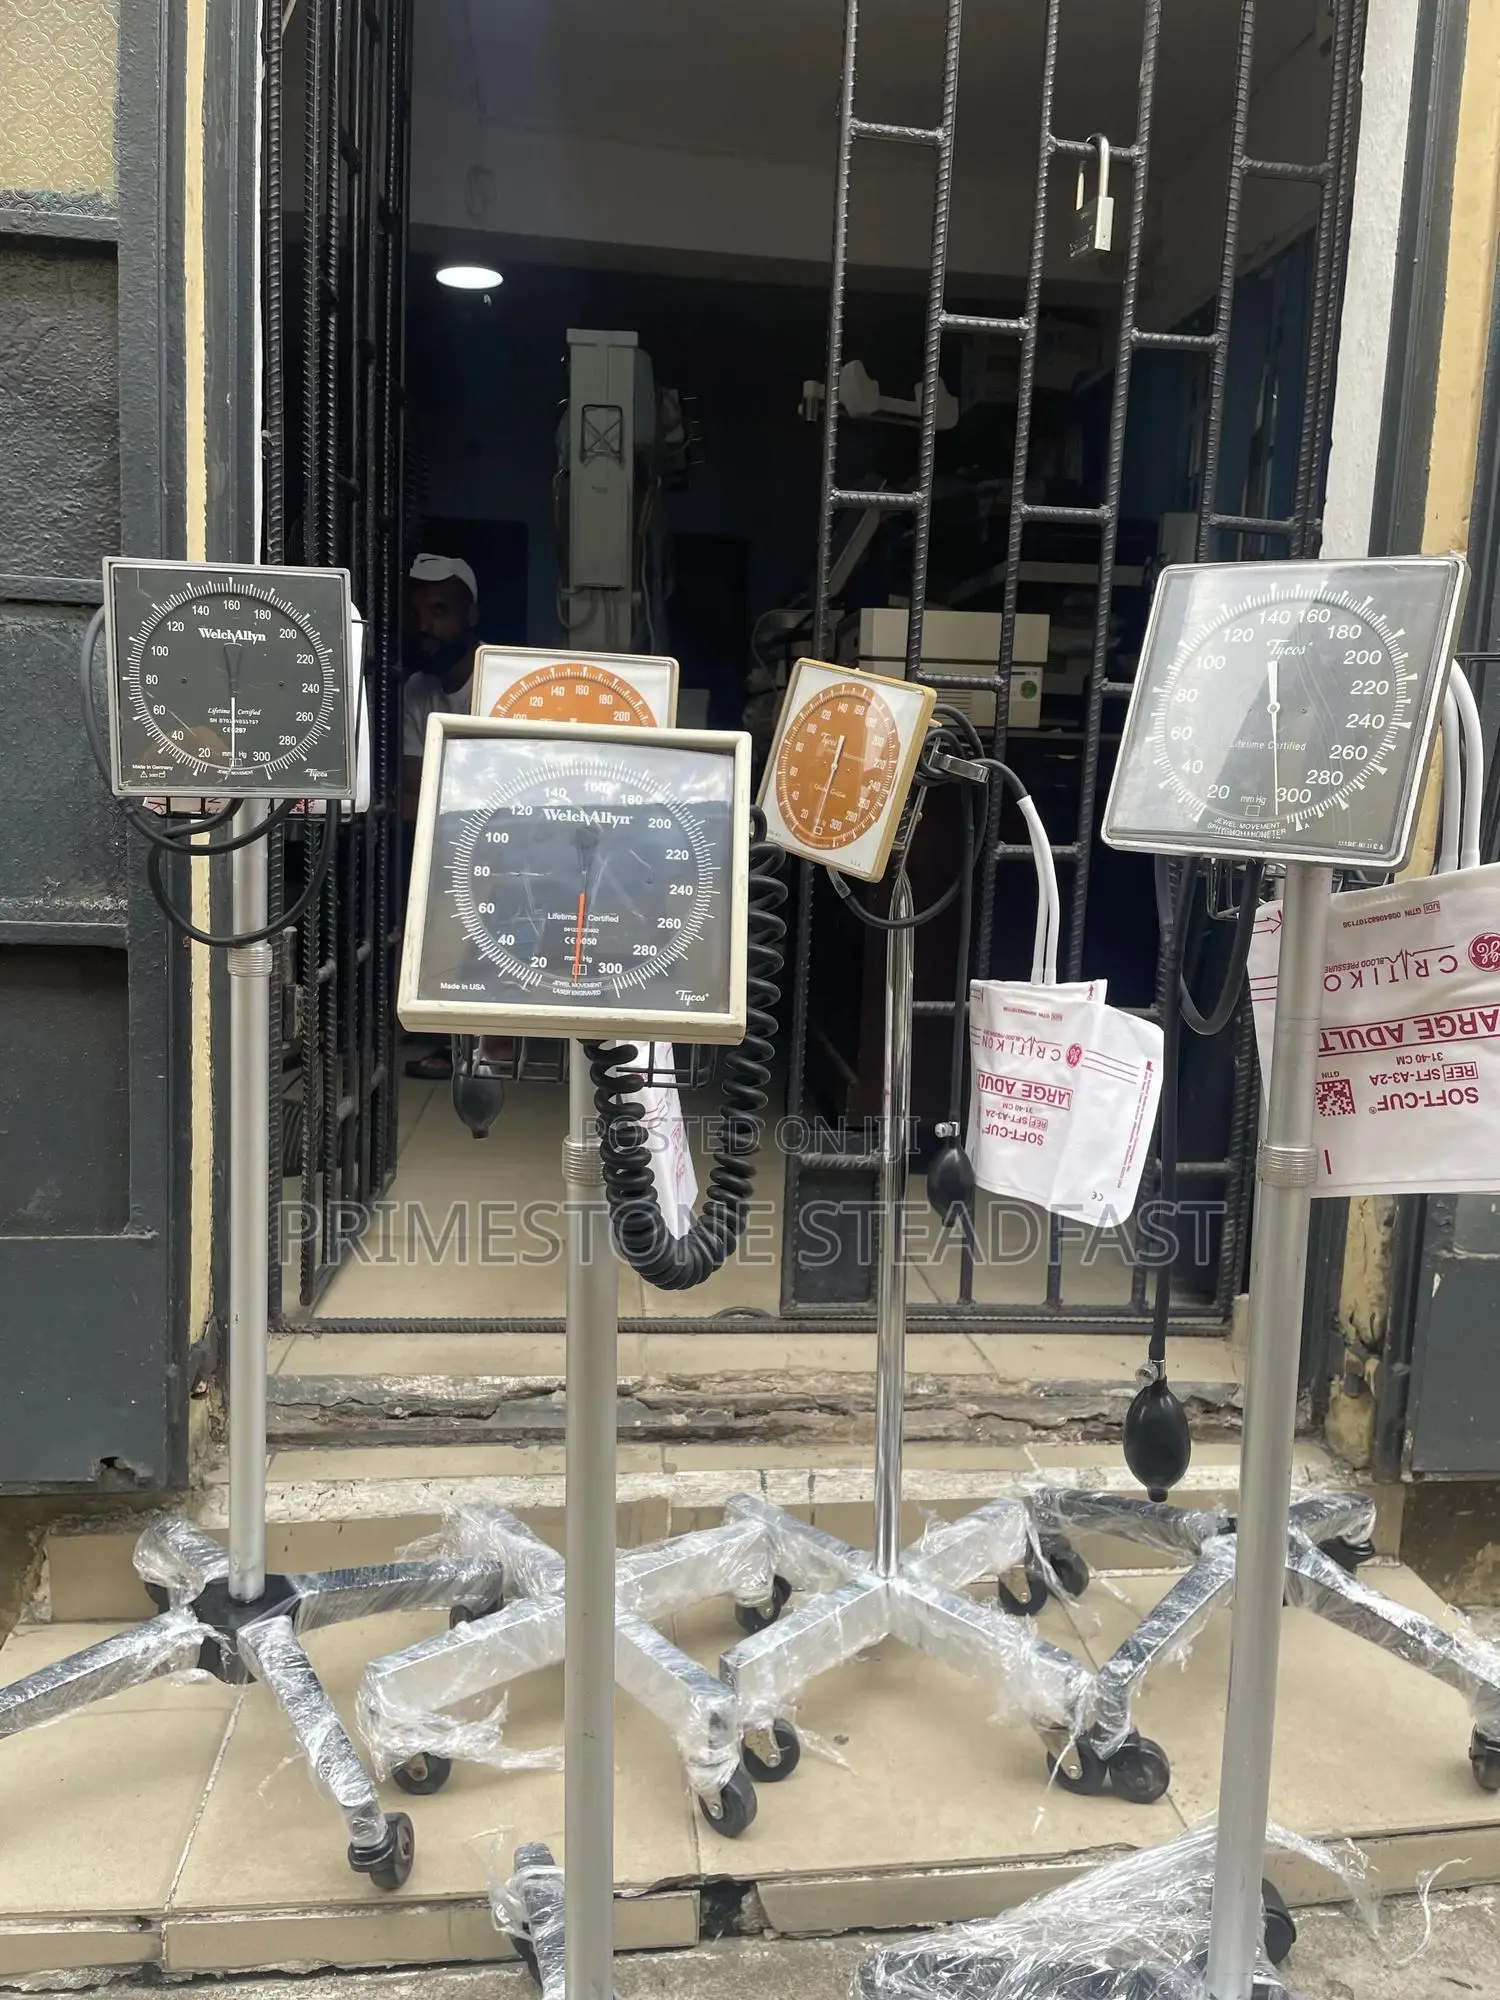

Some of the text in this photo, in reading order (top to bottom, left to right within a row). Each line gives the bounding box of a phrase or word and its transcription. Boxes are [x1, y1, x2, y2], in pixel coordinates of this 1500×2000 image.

[192, 606, 210, 615] 140
[223, 601, 241, 610] 160
[254, 610, 271, 620] 180
[1259, 610, 1291, 624] 140
[1298, 609, 1331, 623] 160
[167, 622, 184, 632] 120
[1327, 625, 1362, 639] 180
[198, 628, 266, 645] WelchAllyn
[279, 629, 297, 639] 200
[1223, 629, 1254, 642] 120
[152, 647, 169, 657] 100
[1266, 639, 1307, 659] Tycos
[297, 655, 314, 665] 220
[1196, 655, 1226, 669] 100
[1343, 650, 1382, 665] 200
[146, 675, 159, 685] 80
[302, 684, 320, 694] 240
[551, 686, 565, 697] 140
[575, 685, 590, 696] 160
[1350, 680, 1389, 695] 220
[599, 694, 613, 705] 180
[1176, 689, 1198, 702] 80
[529, 696, 544, 707] 120
[153, 705, 166, 715] 60
[296, 712, 314, 722] 260
[613, 711, 630, 722] 200
[1346, 714, 1385, 729] 240
[171, 731, 184, 741] 40
[1170, 726, 1193, 740] 60
[279, 736, 297, 746] 280
[1268, 740, 1307, 751] Certified
[198, 747, 211, 758] 20
[253, 751, 271, 761] 300
[1329, 744, 1368, 760] 260
[1181, 760, 1204, 774] 40
[1305, 769, 1344, 786] 280
[867, 779, 881, 792] 240
[543, 787, 567, 798] 140
[1206, 784, 1230, 799] 20
[1276, 787, 1312, 804] 300
[620, 794, 643, 805] 180
[1255, 794, 1267, 805] Hg
[510, 805, 533, 816] 120
[800, 808, 809, 819] 20
[543, 808, 630, 829] WelchAllyn
[648, 818, 672, 829] 200
[1214, 816, 1281, 830] JEWEL MOVEMENT
[485, 833, 509, 844] 100
[665, 850, 689, 861] 220
[474, 866, 491, 877] 80
[669, 885, 694, 896] 240
[478, 903, 495, 914] 60
[1404, 908, 1422, 917] GTIN
[547, 912, 619, 923] Lifetime Certified
[657, 918, 682, 929] 260
[498, 935, 515, 946] 40
[633, 945, 657, 956] 280
[530, 957, 548, 968] 20
[582, 955, 593, 964] Hg
[598, 962, 623, 974] 300
[1324, 957, 1385, 974] BLOOD PRESSURE
[1324, 953, 1458, 992] CRITIKO
[440, 982, 461, 990] Made
[469, 983, 486, 991] USA
[675, 989, 706, 1006] Tycos
[1318, 1009, 1500, 1052] ARGE ADULT
[981, 1036, 1061, 1062] CRITIKON
[1396, 1052, 1444, 1065] 31-40 CM
[1321, 1070, 1340, 1079] GTIN
[1369, 1065, 1475, 1086] REF SFT-A3-2A
[1021, 1083, 1071, 1108] LARGE
[1002, 1102, 1014, 1110] CM
[985, 1108, 1029, 1126] SFT-A3-2A
